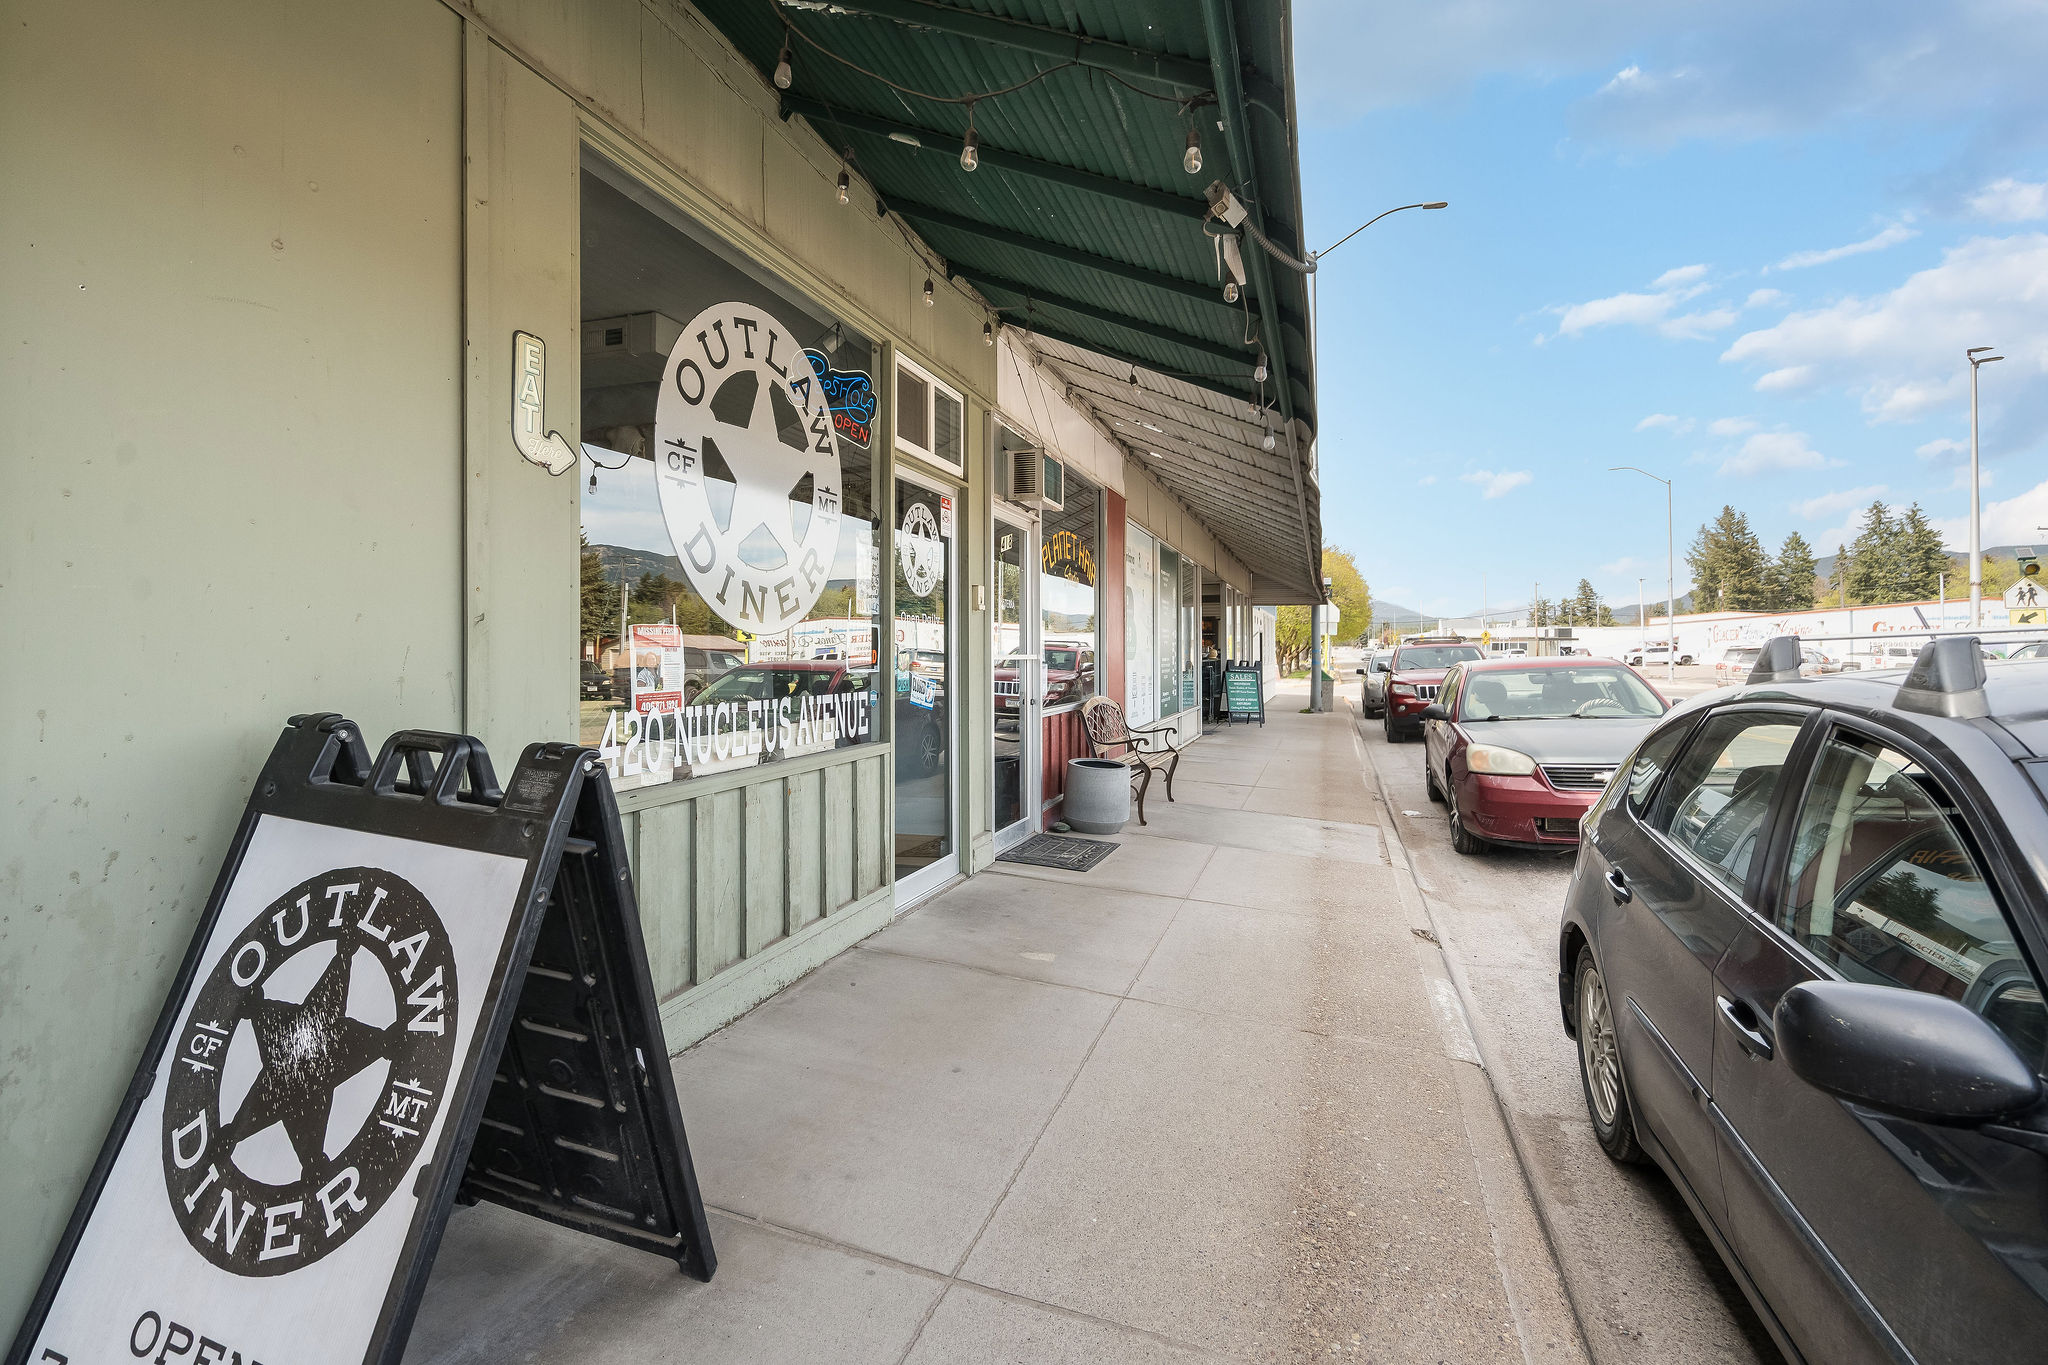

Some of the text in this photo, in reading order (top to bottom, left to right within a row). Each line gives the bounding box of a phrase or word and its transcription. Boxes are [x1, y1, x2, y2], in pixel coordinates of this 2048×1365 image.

[520, 342, 541, 433] EAT
[676, 317, 834, 457] OUTLAW
[835, 414, 868, 443] OPEN
[667, 451, 696, 474] CF
[818, 496, 837, 514] MT
[904, 507, 938, 541] OUTLAW
[683, 522, 825, 624] DINER
[1041, 531, 1077, 576] PLANET
[905, 567, 936, 593] DINER
[599, 691, 869, 778] 420 NUCLEUS AVENUE
[230, 883, 445, 1037] OUTLAW
[190, 1033, 223, 1057] CF
[386, 1090, 428, 1122] MT
[171, 1108, 367, 1261] DINER
